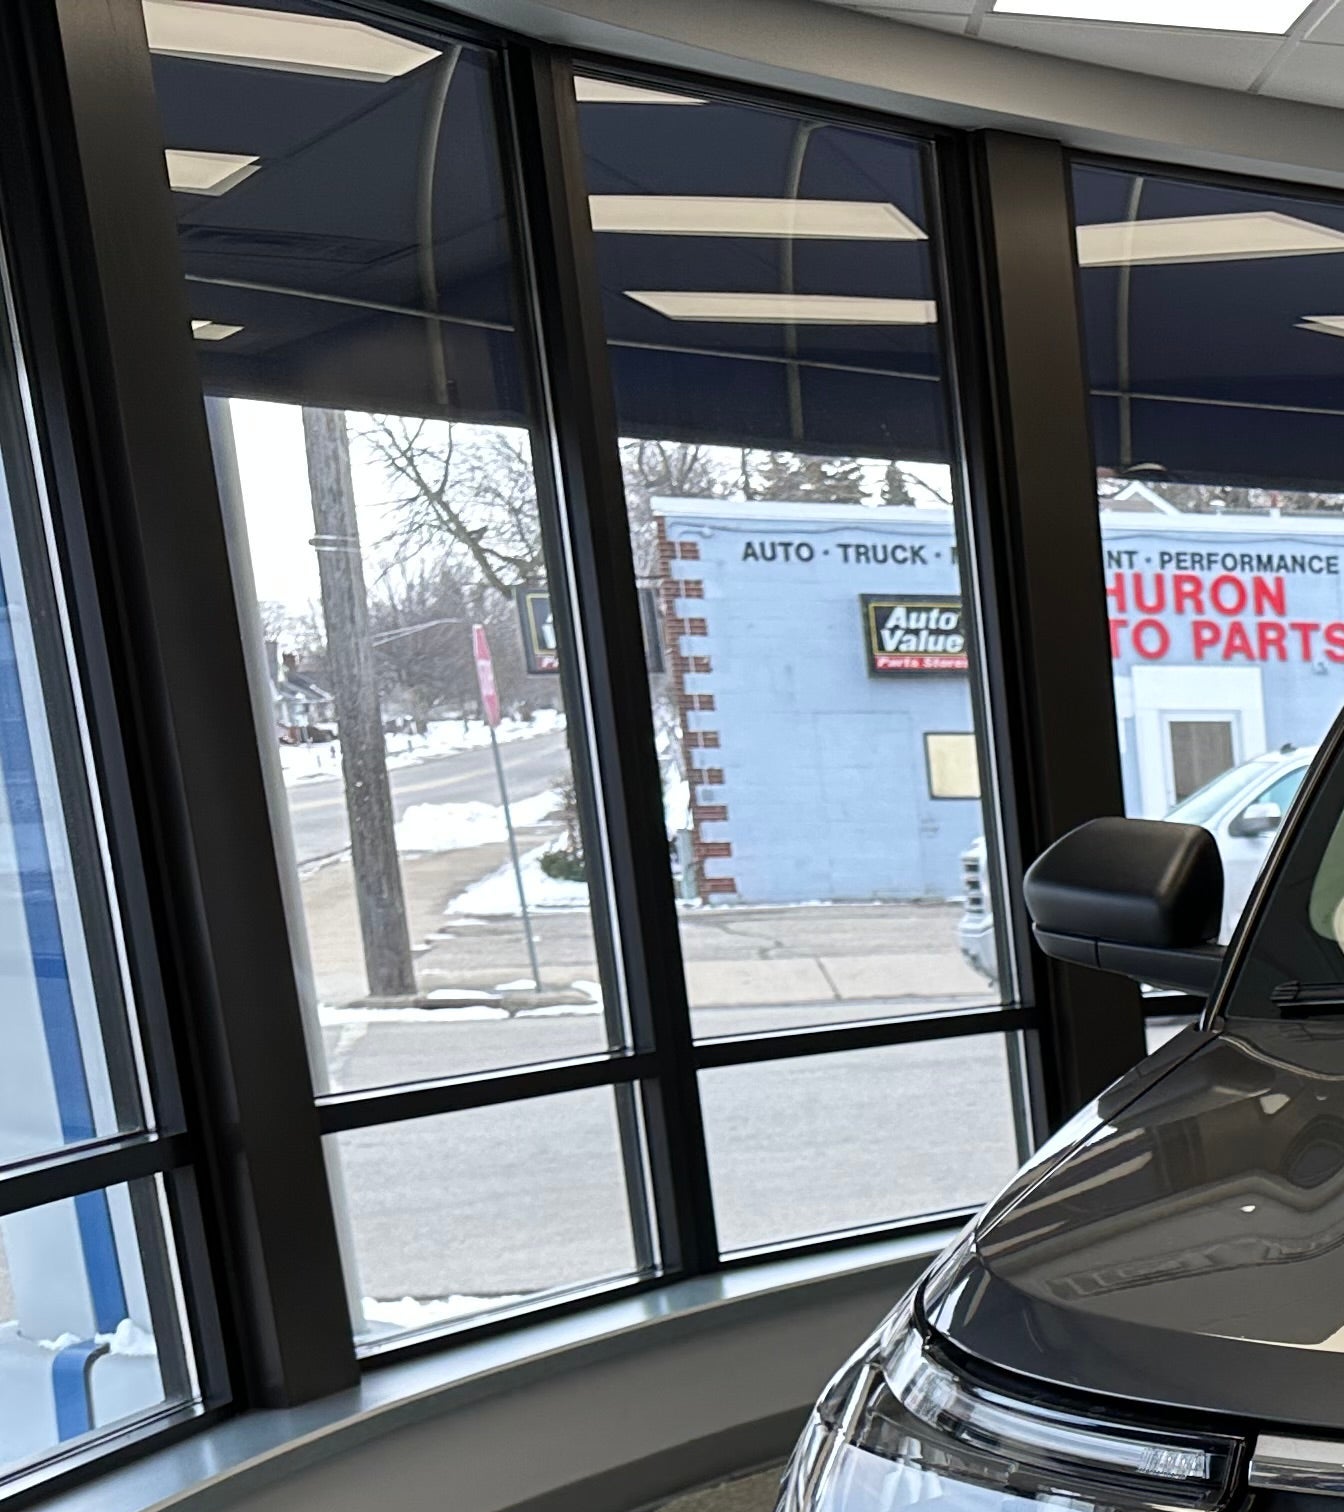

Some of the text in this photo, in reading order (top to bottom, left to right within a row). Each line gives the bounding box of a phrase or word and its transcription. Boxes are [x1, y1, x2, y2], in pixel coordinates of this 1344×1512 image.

[742, 541, 814, 562] AUTO
[836, 543, 928, 565] TRUCK
[1159, 551, 1339, 575] PERFORMANCE
[1106, 572, 1287, 617] HURON
[886, 605, 958, 630] Auto
[880, 628, 965, 653] Value
